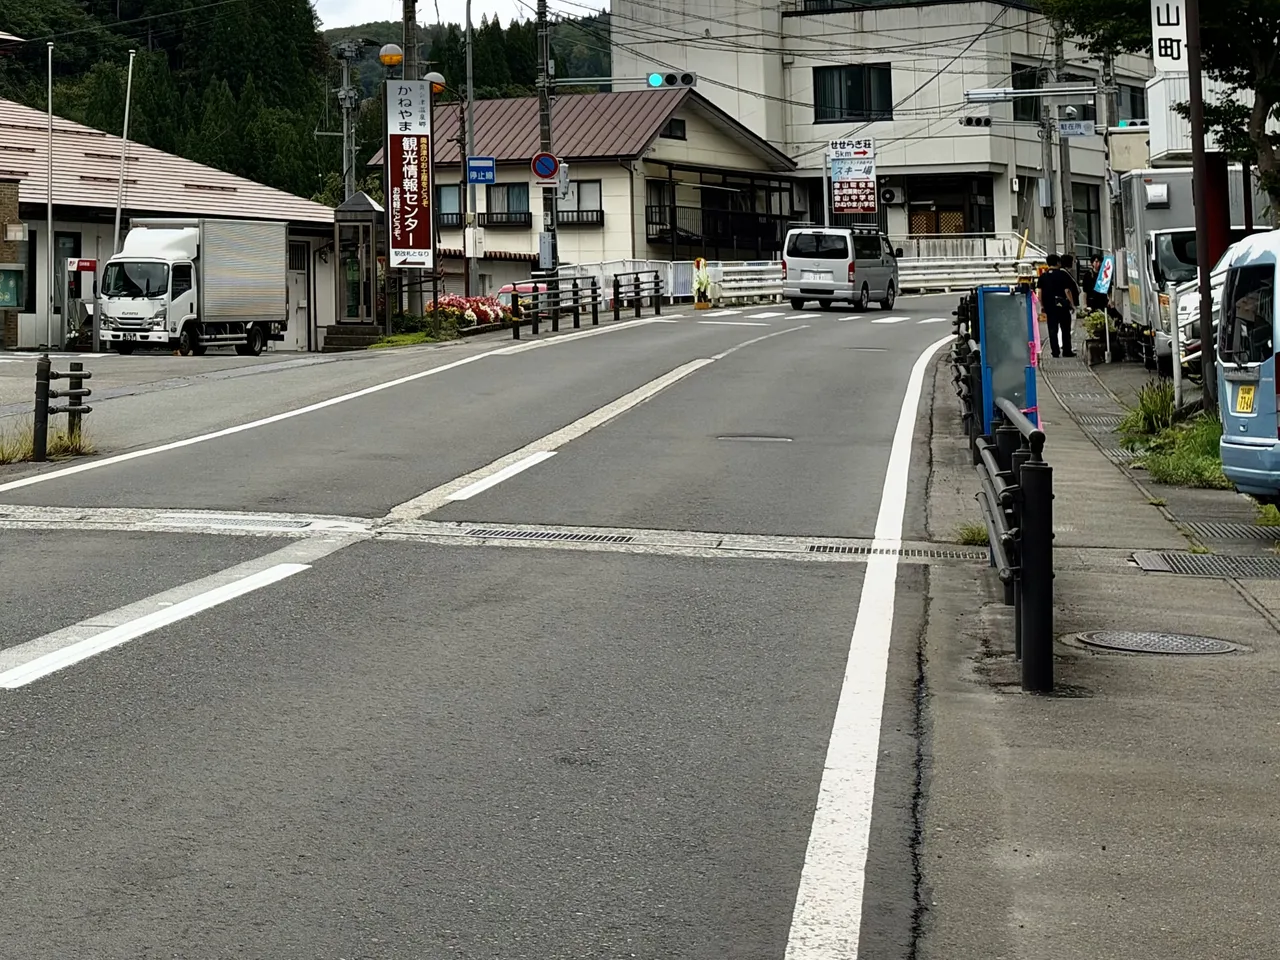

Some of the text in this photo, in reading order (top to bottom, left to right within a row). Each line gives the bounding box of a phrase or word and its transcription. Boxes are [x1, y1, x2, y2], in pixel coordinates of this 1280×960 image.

[397, 85, 413, 132] かねやま
[831, 139, 871, 149] せせらぎ荘
[835, 150, 851, 158] 5km
[469, 170, 493, 180] 停止線
[834, 165, 873, 176] スキー場
[402, 136, 418, 247] 観光情報センター
